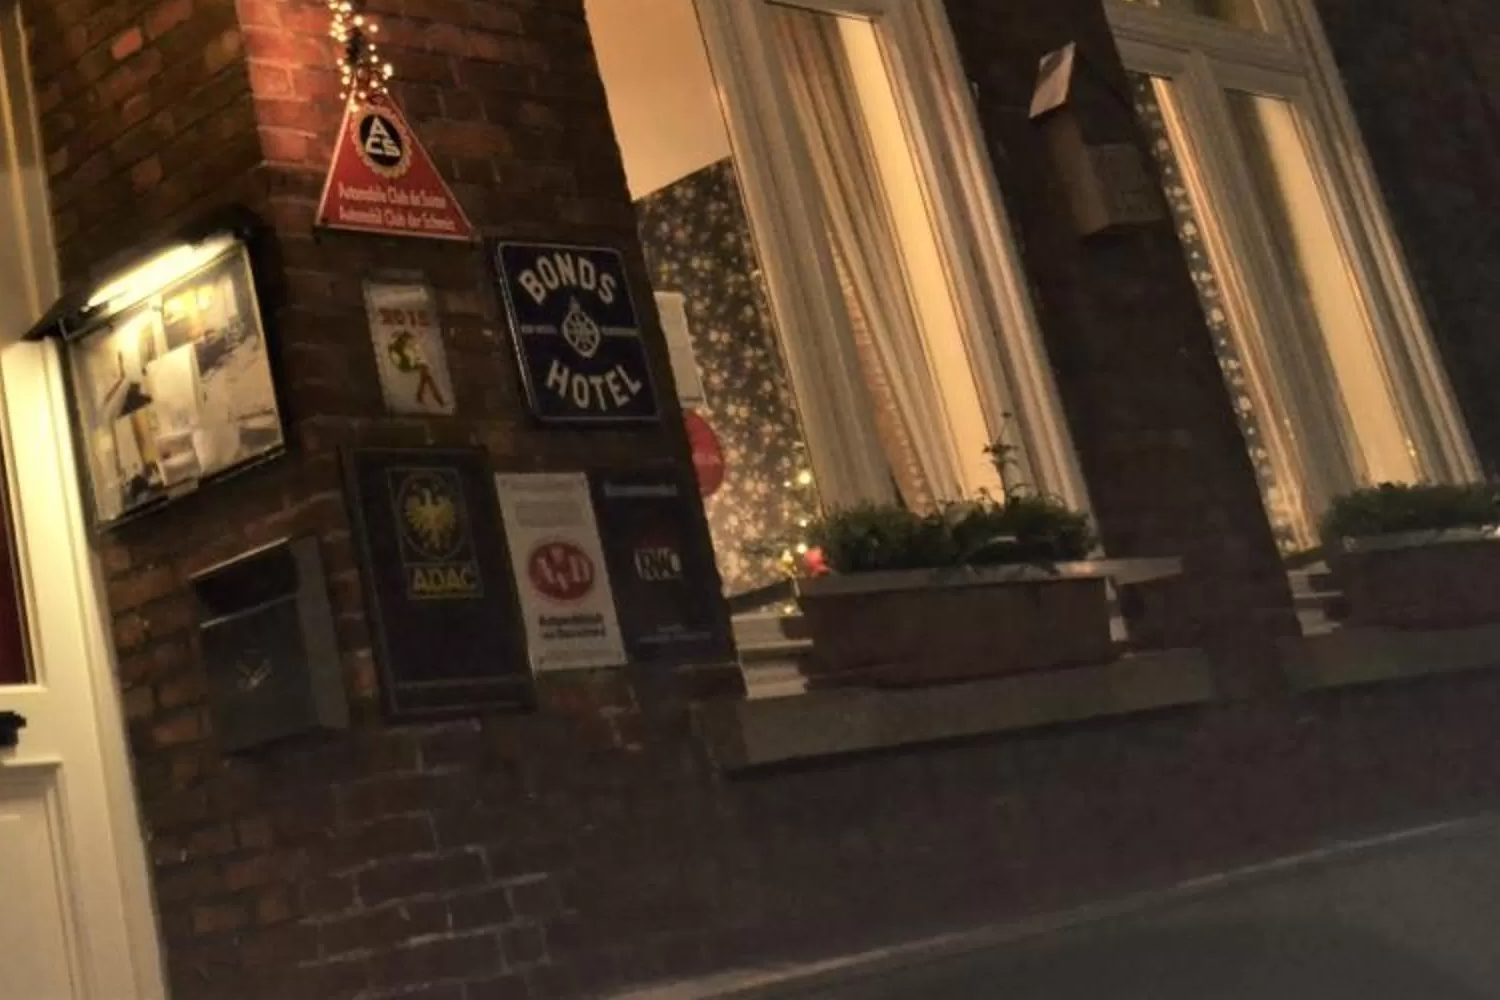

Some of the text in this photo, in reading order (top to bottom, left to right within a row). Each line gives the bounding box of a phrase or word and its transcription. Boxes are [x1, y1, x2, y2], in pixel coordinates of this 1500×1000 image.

[518, 252, 617, 304] BONDS
[547, 359, 642, 412] HOTEL
[411, 568, 477, 591] ADAC
